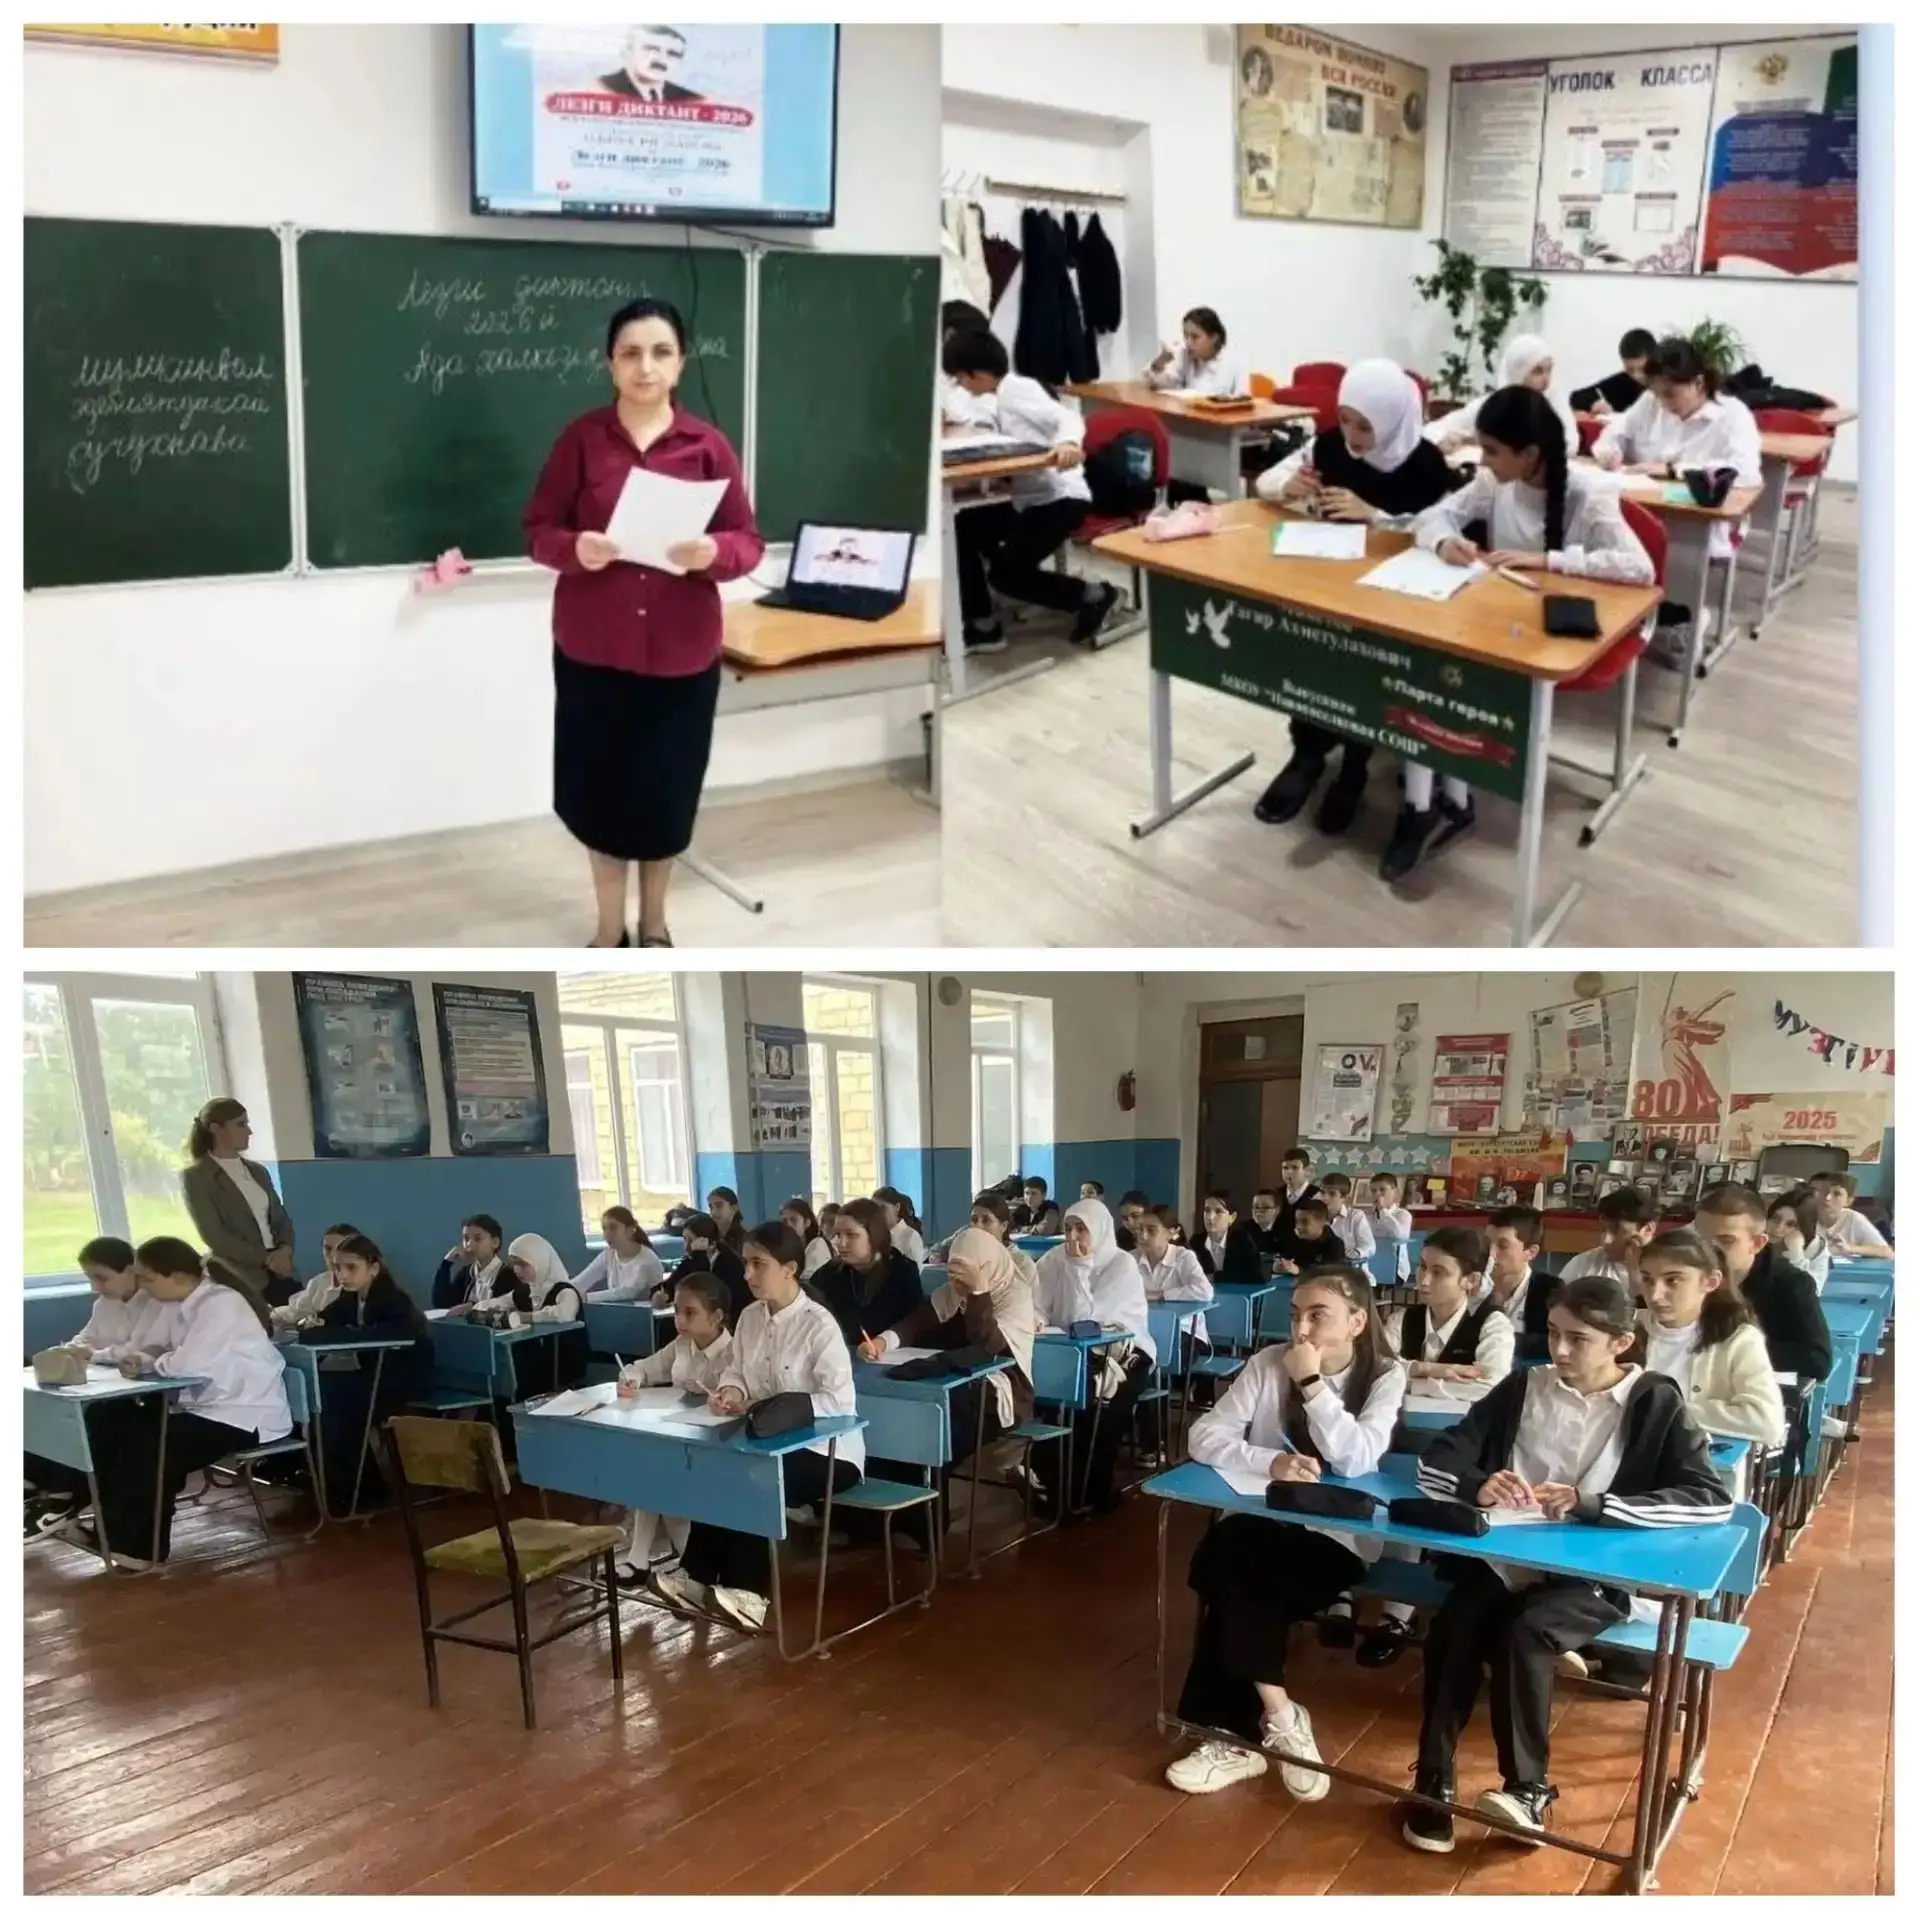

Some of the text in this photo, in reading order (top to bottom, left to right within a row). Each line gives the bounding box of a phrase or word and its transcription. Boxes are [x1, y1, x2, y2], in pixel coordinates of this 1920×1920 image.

[1550, 71, 1616, 93] УГОЛОК
[1641, 63, 1713, 86] КЛАССА
[617, 100, 699, 120] ДИКТАНТ
[1394, 679, 1499, 726] Парта героя
[1631, 1079, 1683, 1118] 80
[1783, 1110, 1838, 1130] 2025
[1641, 1124, 1720, 1145] ОБЕДА!
